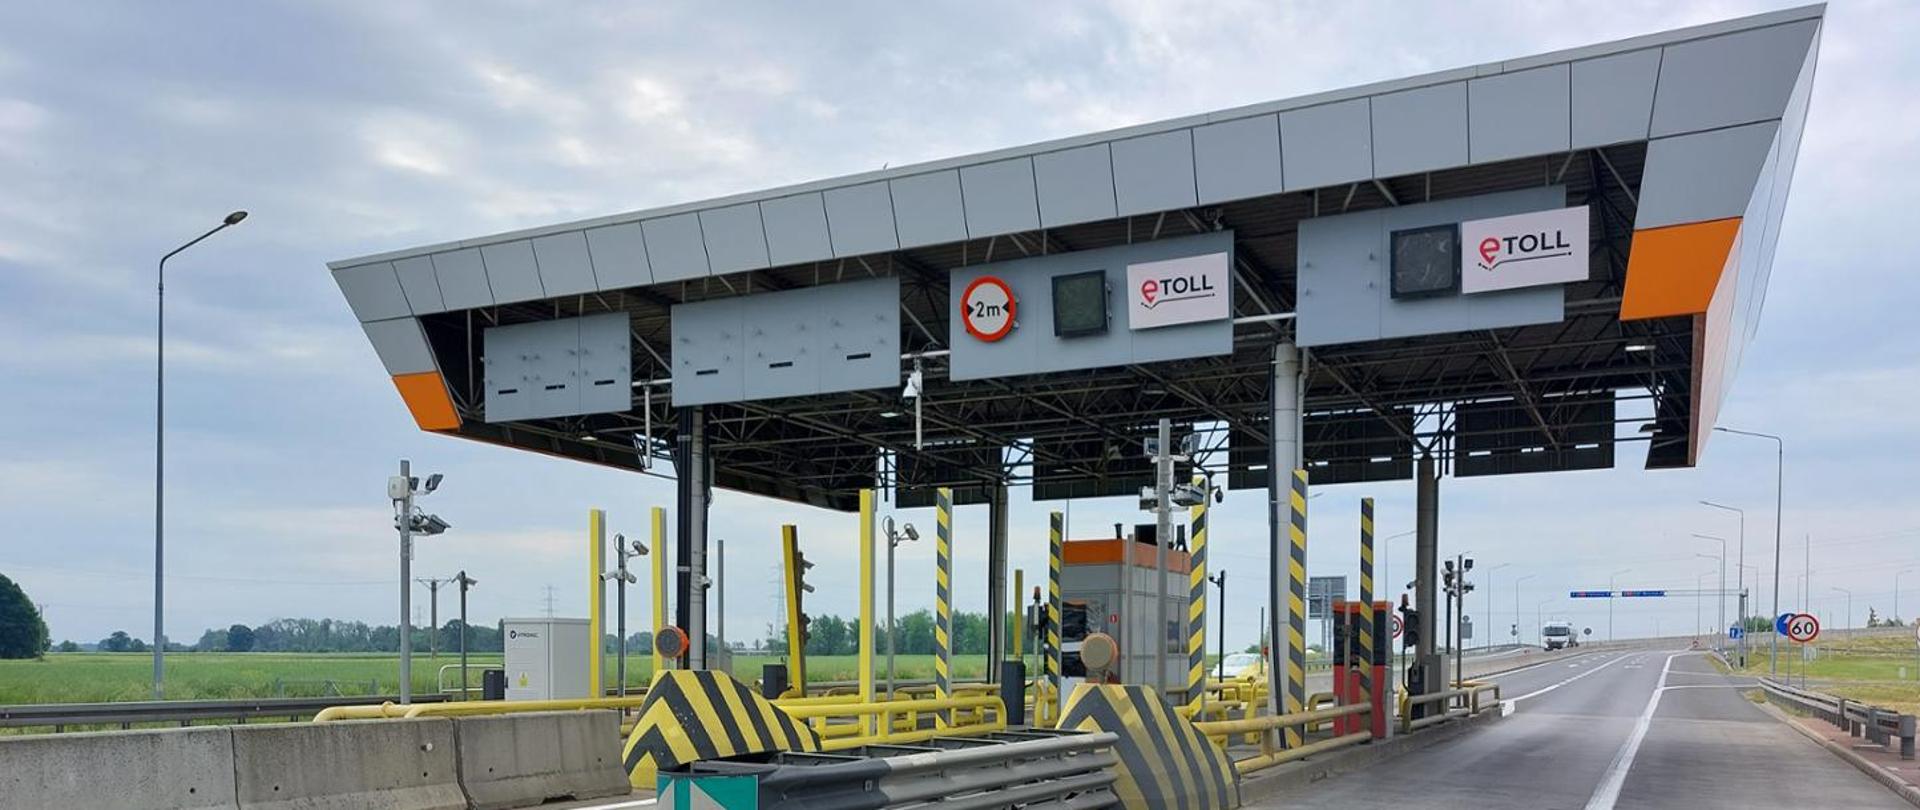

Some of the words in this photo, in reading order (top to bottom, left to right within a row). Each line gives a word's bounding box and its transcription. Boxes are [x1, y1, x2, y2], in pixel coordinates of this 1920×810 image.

[1479, 230, 1570, 264] eTOLL
[1141, 274, 1214, 304] eTOLL
[1791, 621, 1814, 635] 60
